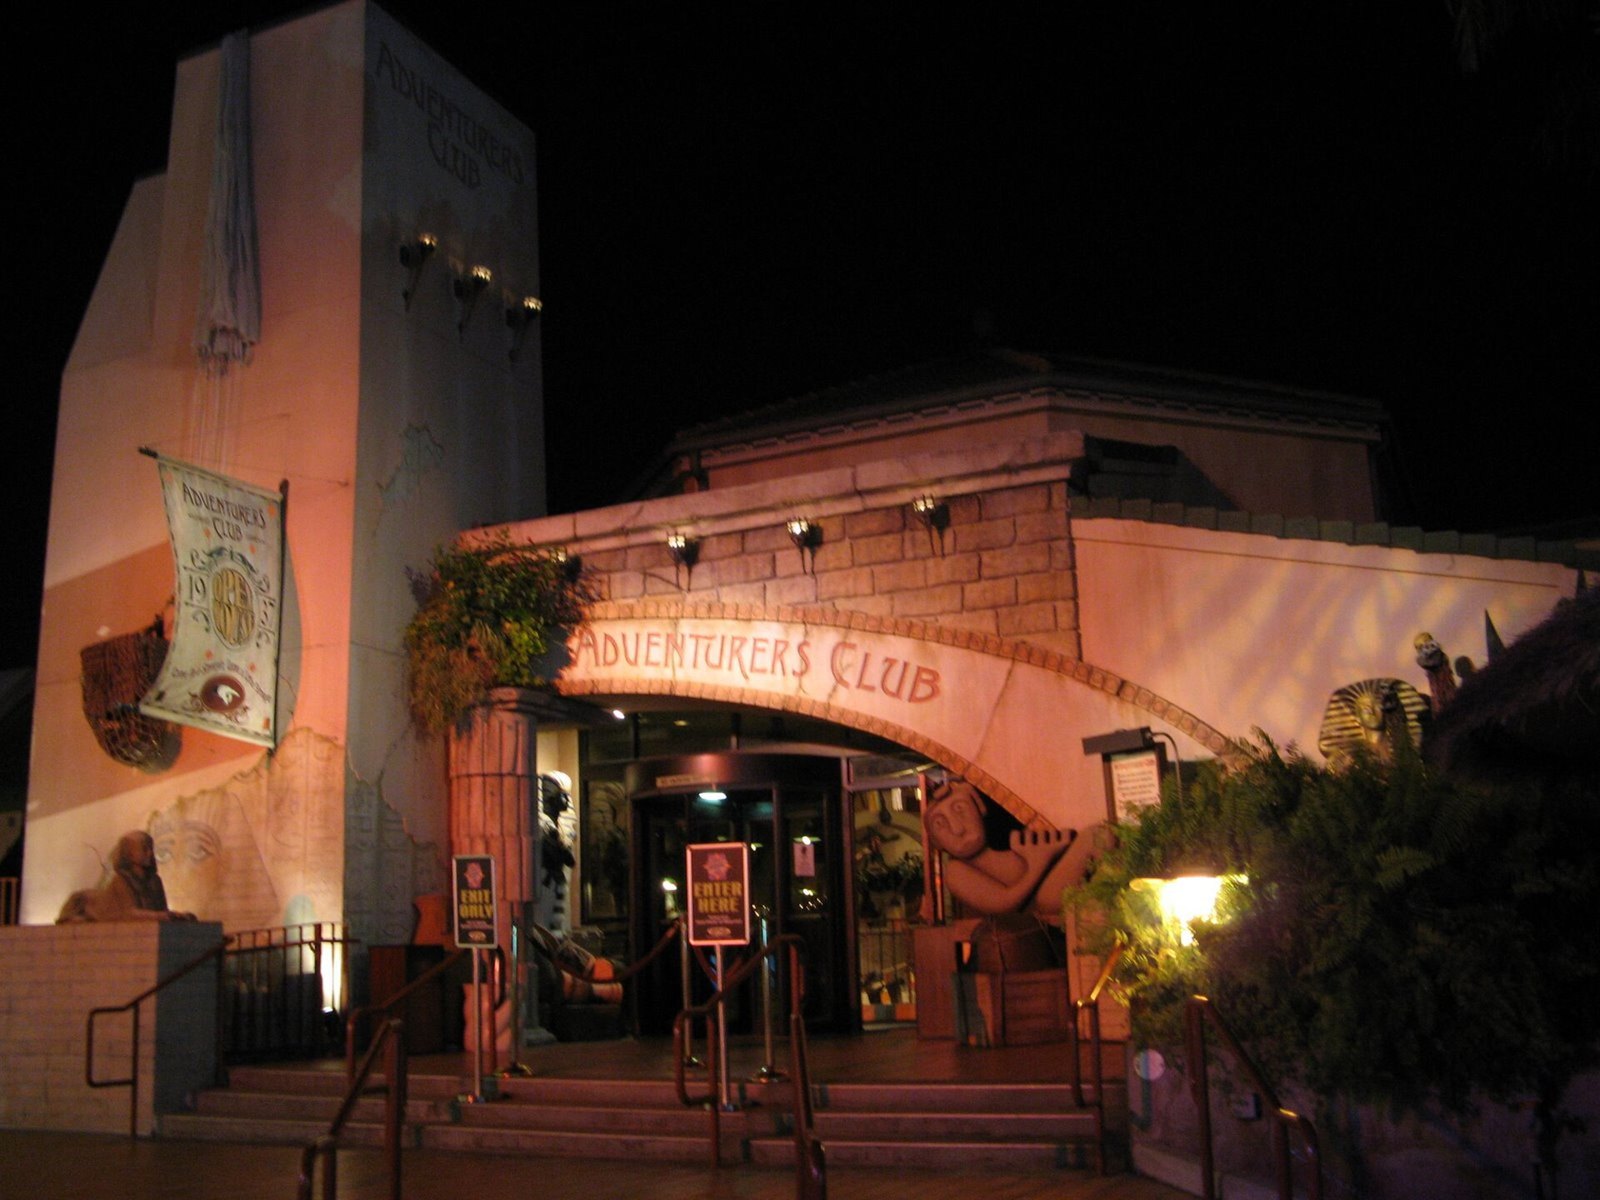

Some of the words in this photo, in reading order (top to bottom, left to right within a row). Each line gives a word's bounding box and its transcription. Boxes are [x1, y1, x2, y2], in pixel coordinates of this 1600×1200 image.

[428, 120, 481, 188] CLUB
[211, 517, 243, 542] CLUB
[831, 641, 942, 704] CLUB
[461, 889, 491, 904] EXIT
[694, 881, 742, 898] ENTER
[459, 904, 493, 919] ONLY
[697, 897, 740, 913] HERE
